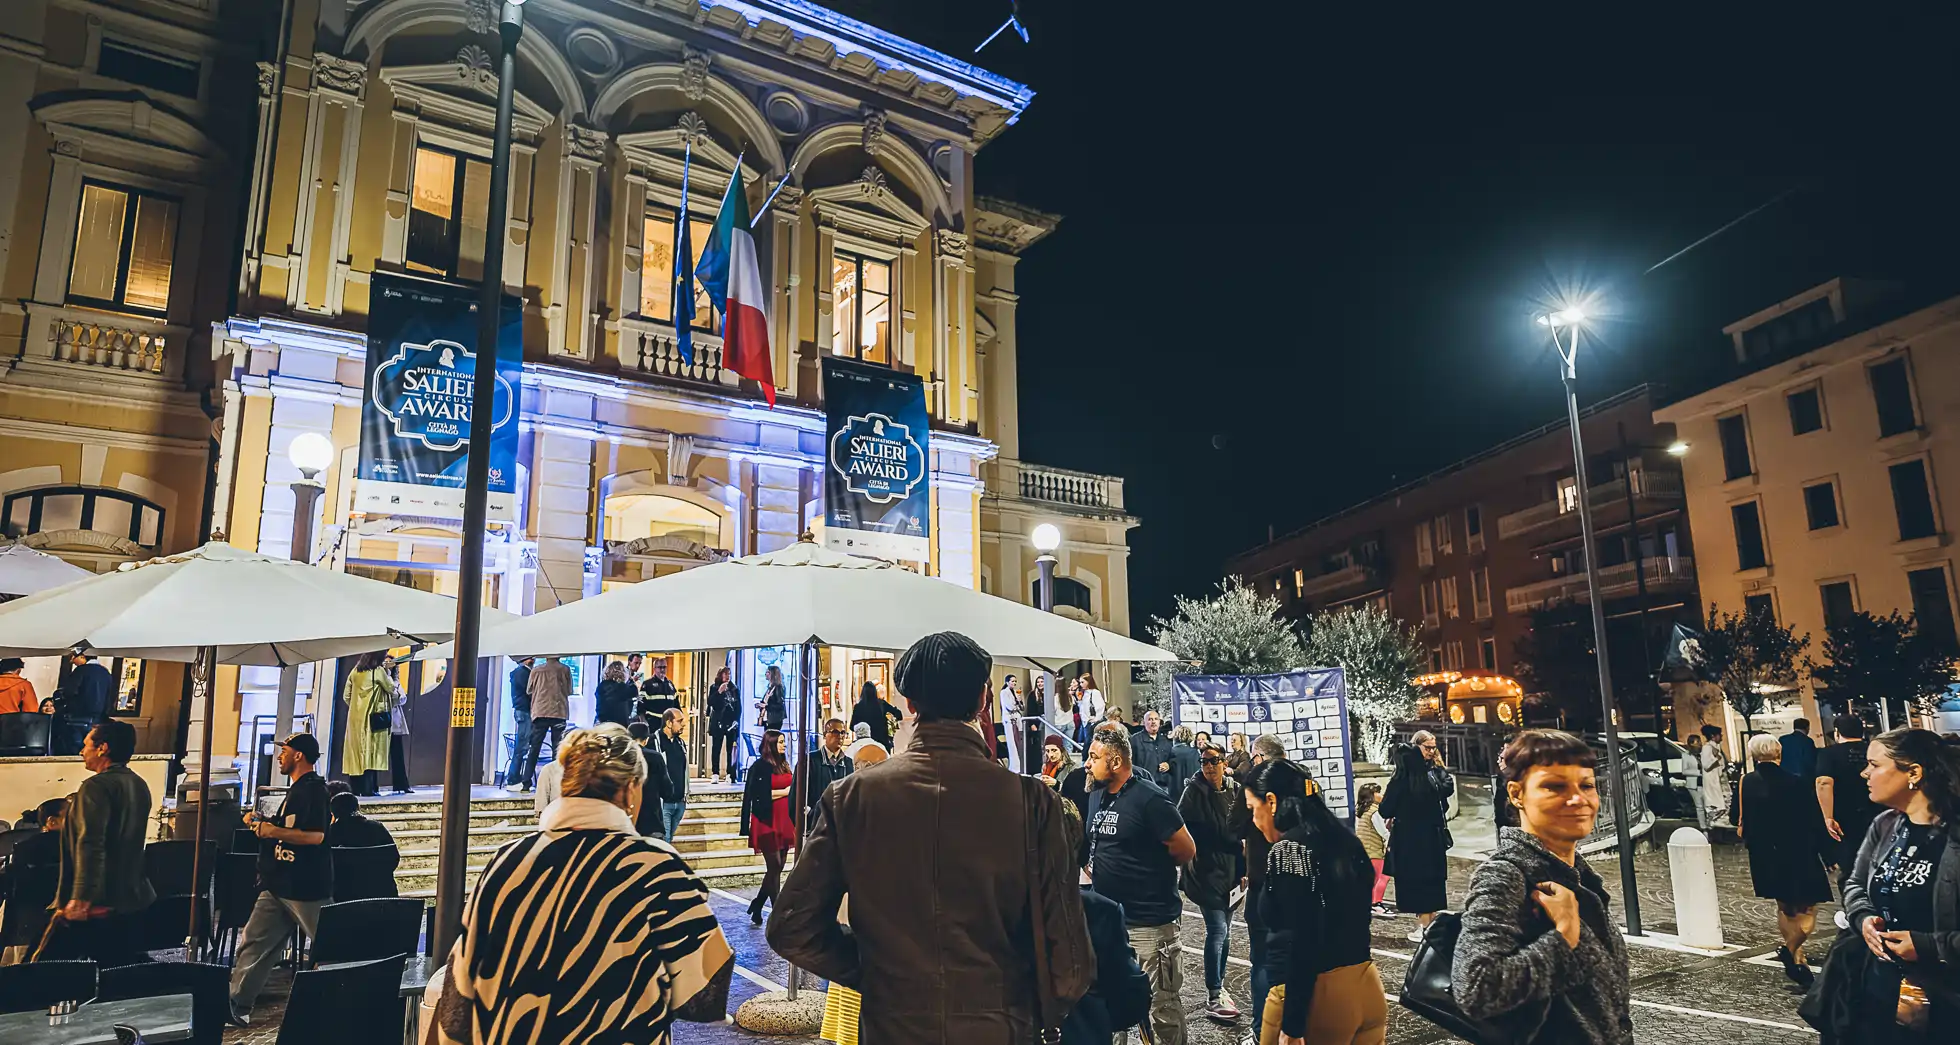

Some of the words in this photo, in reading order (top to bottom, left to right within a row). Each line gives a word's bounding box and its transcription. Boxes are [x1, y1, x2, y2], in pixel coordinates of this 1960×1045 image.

[417, 366, 475, 381] INTERNATIONA
[403, 369, 474, 398] SALIE
[424, 393, 466, 404] CIRCUS
[398, 397, 473, 422] AWAR
[426, 426, 459, 435] LEGNAGO
[859, 435, 902, 446] INTERNATIONAL
[850, 437, 907, 461] SALIERI
[865, 456, 894, 464] CIRCUS
[849, 460, 909, 480] AWARD
[452, 707, 475, 717] 6033
